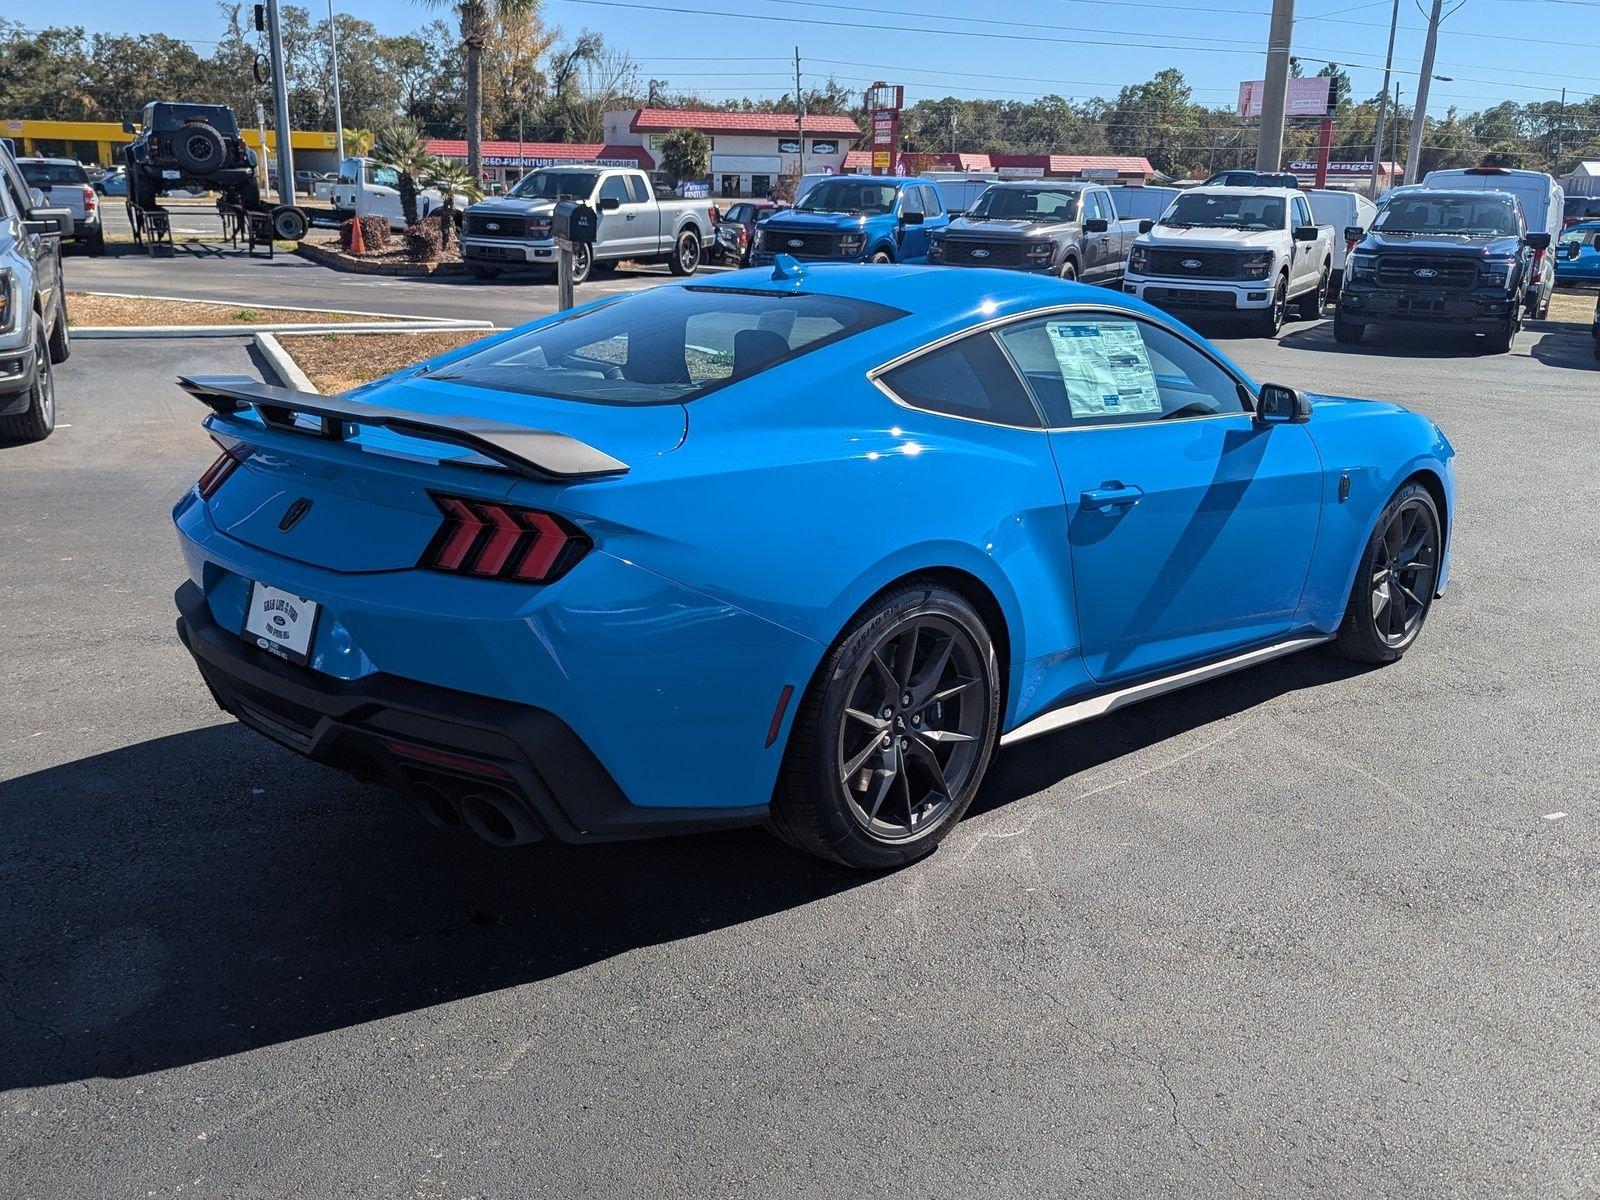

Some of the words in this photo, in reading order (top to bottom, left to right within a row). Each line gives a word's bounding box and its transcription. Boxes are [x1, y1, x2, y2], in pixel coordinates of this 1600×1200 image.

[482, 157, 502, 166] SED
[597, 160, 638, 168] ANTIQUES
[1416, 269, 1436, 277] Ford
